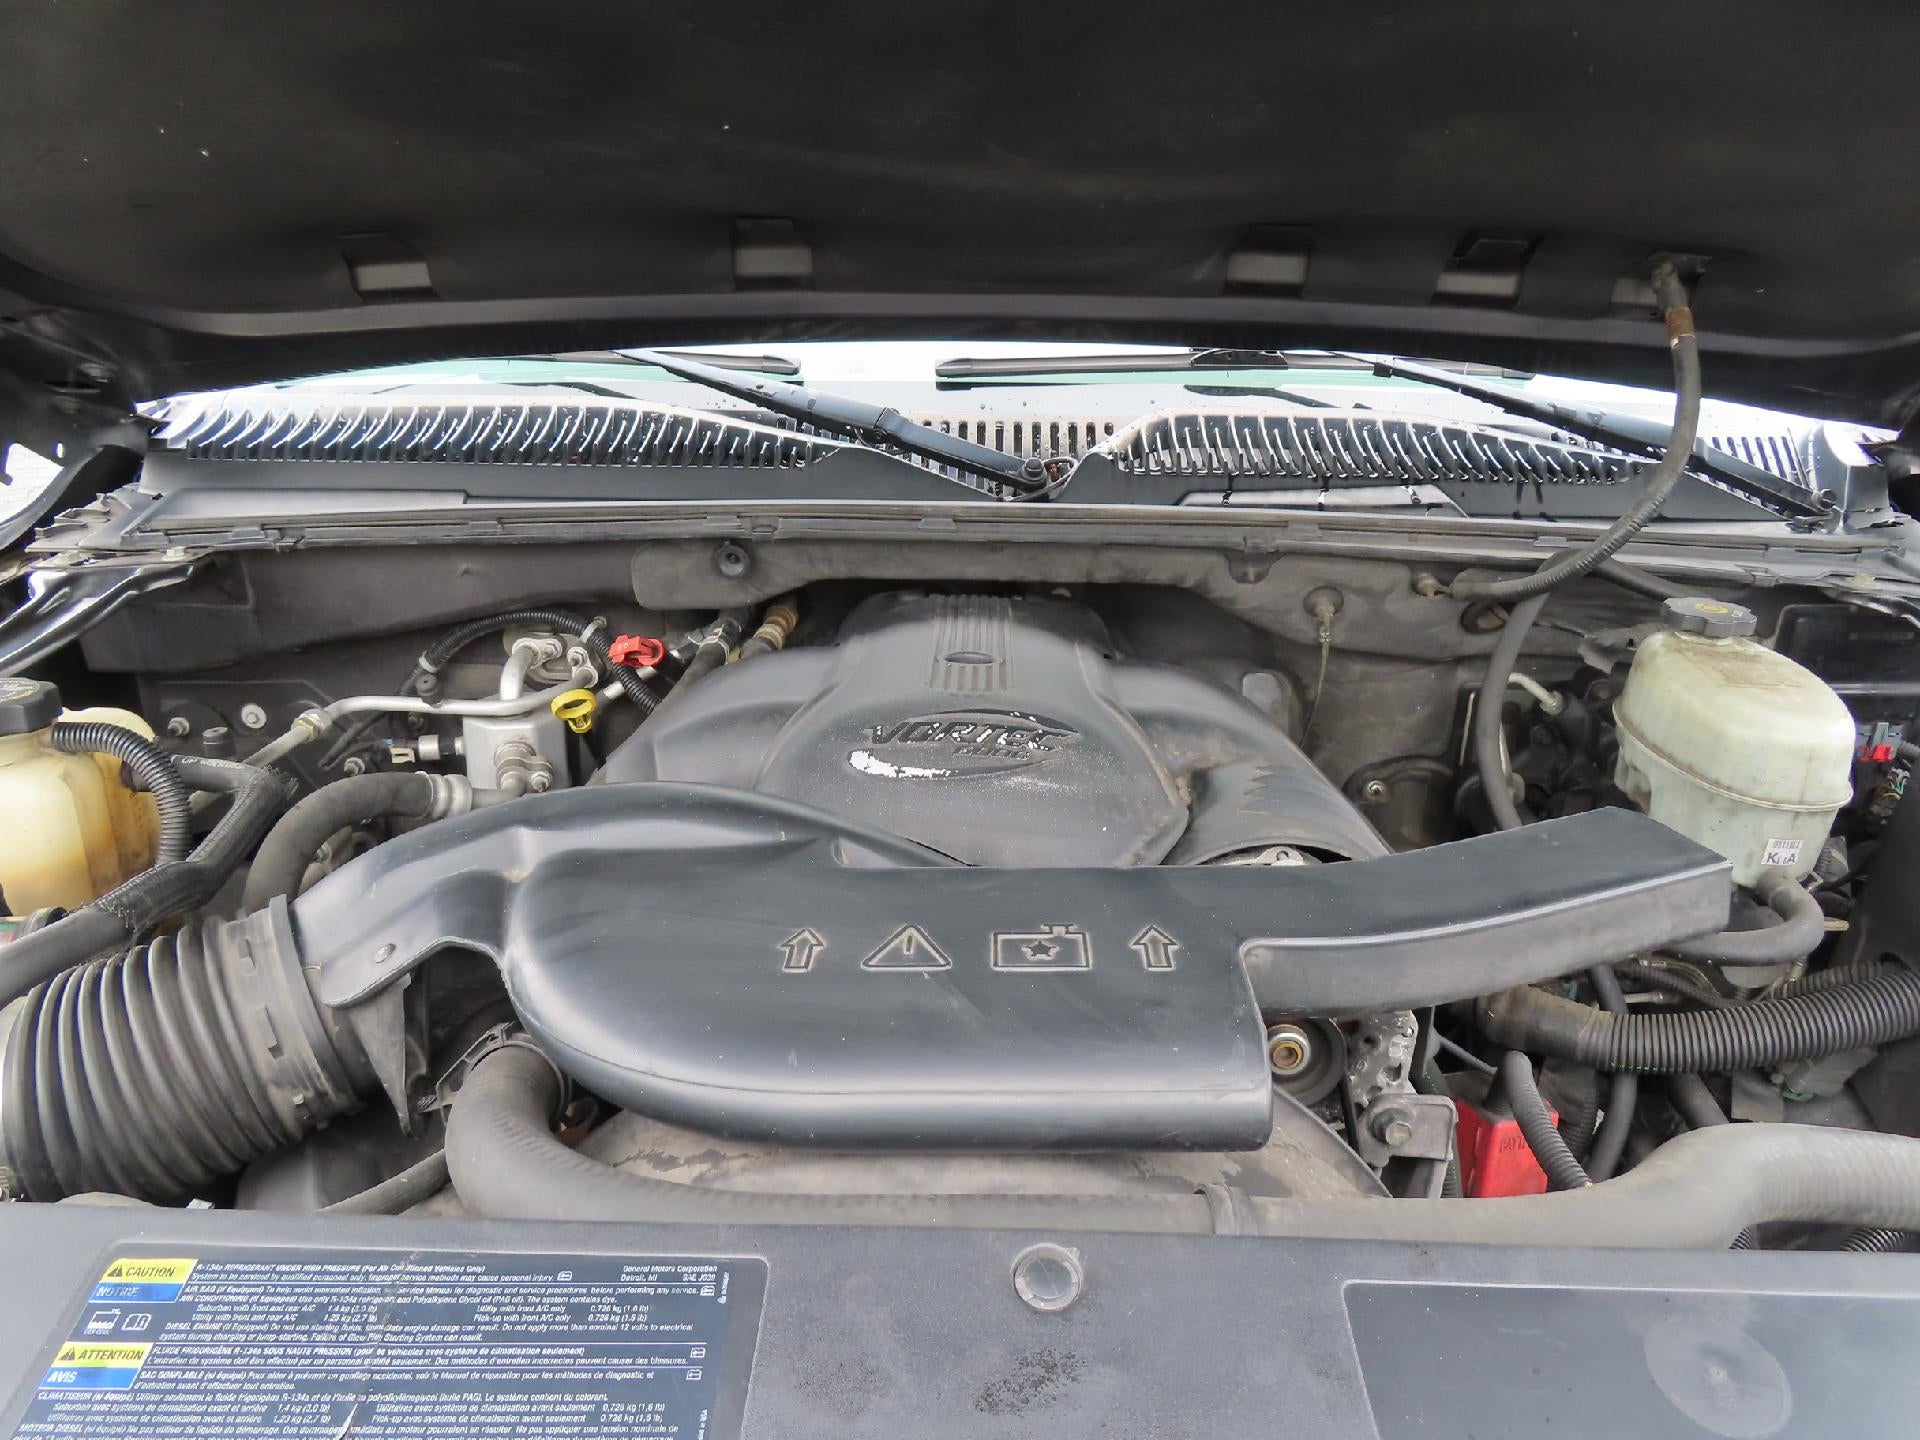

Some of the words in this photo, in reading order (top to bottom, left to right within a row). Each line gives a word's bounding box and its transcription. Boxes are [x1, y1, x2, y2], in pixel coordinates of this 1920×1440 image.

[125, 1266, 176, 1277] CAUTION
[676, 1265, 718, 1273] Corporation
[478, 1273, 498, 1281] cause
[503, 1286, 518, 1294] and
[541, 1296, 569, 1304] system
[555, 1314, 572, 1322] only
[528, 1323, 549, 1332] apply
[550, 1323, 569, 1331] more
[444, 1333, 459, 1341] can
[77, 1349, 145, 1360] ATTENTION
[263, 1346, 285, 1356] SOUS
[286, 1346, 314, 1356] HAUTE
[313, 1346, 353, 1356] PRESSION
[425, 1346, 443, 1356] avec
[491, 1346, 541, 1356] climatisation
[46, 1371, 78, 1382] AVIS
[55, 1424, 83, 1434] DIESEL
[138, 1424, 154, 1434] pas
[282, 1424, 298, 1434] Des
[398, 1424, 426, 1434] moteur
[426, 1424, 469, 1434] pourraient
[528, 1424, 544, 1434] pas
[600, 1424, 629, 1434] tension
[630, 1424, 667, 1434] nominale
